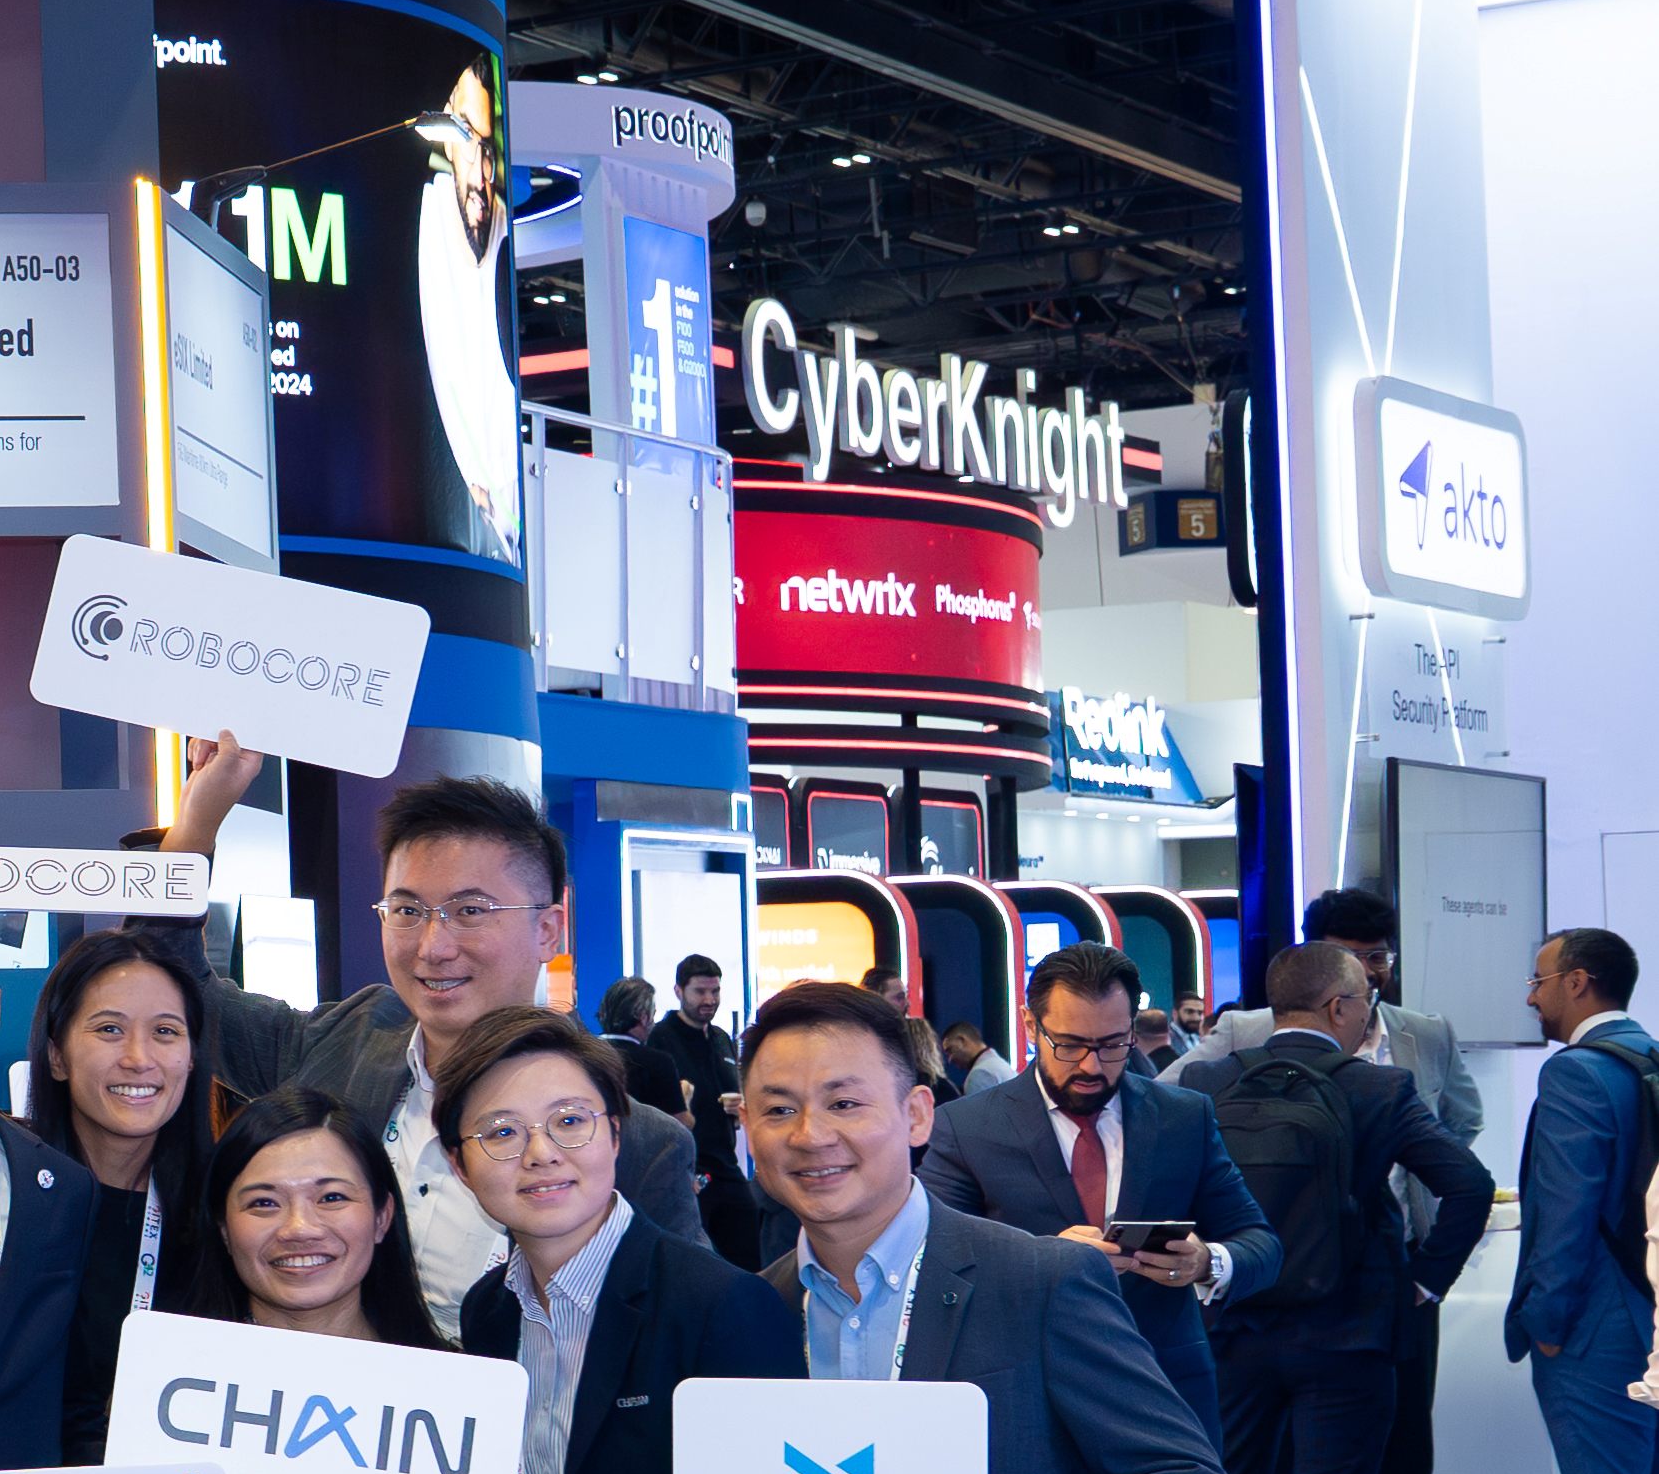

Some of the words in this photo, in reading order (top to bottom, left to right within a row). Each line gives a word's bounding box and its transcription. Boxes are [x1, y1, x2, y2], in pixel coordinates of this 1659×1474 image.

[3, 257, 79, 282] A50-03
[742, 300, 1131, 528] CyberKnight
[21, 433, 42, 452] for
[1191, 514, 1205, 537] 5
[1443, 463, 1507, 552] akto
[780, 568, 917, 618] netwrix
[130, 619, 389, 707] ROBOCORE
[1414, 643, 1437, 676] The
[1062, 686, 1169, 758] Reolink
[1393, 689, 1438, 733] Security
